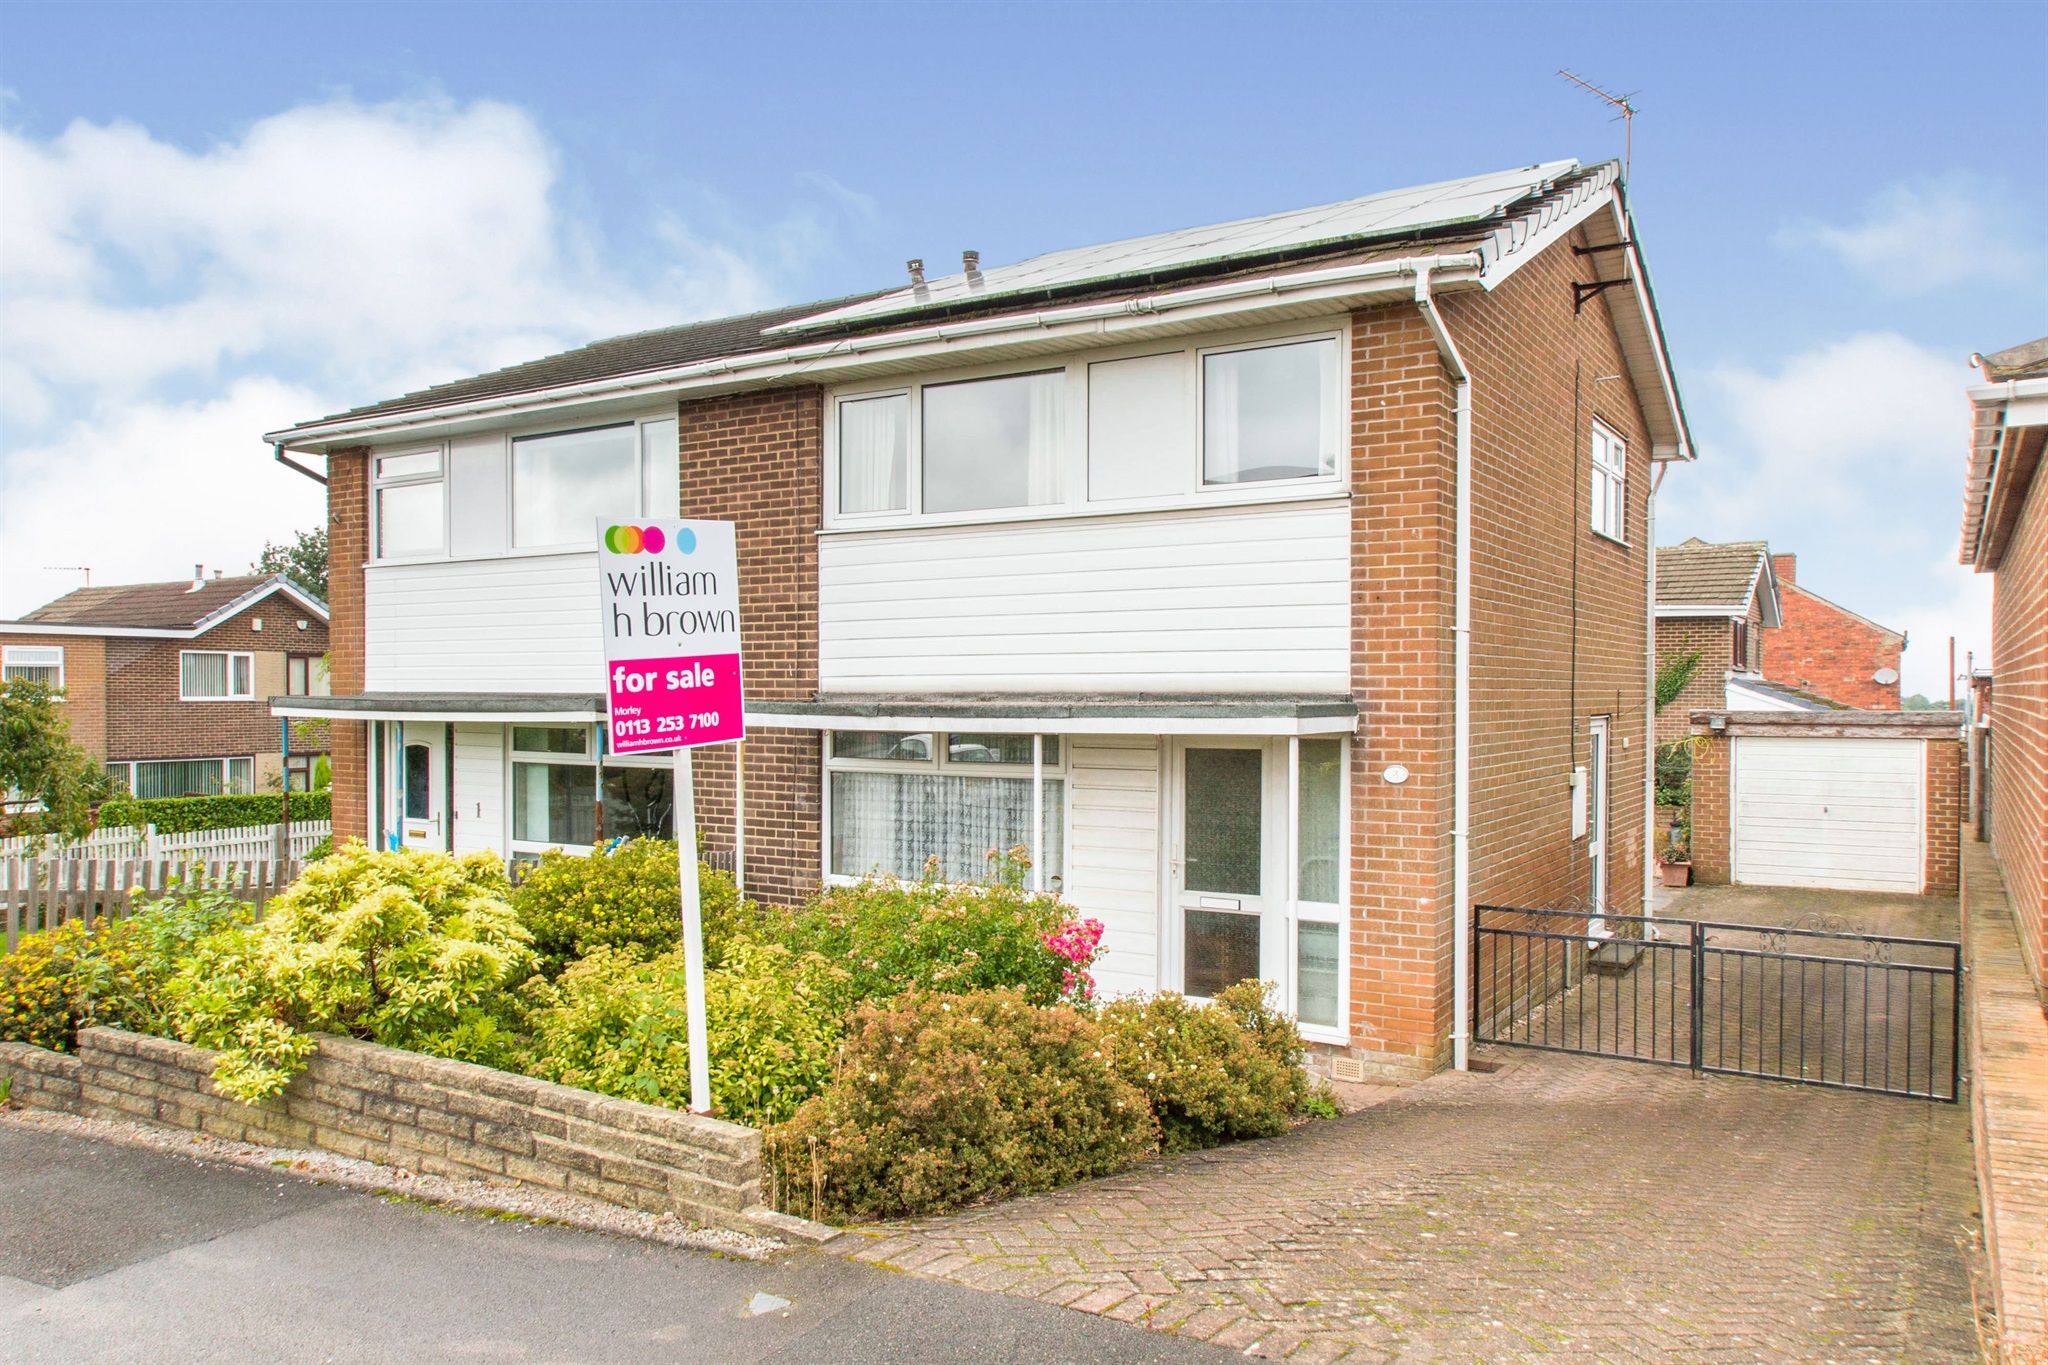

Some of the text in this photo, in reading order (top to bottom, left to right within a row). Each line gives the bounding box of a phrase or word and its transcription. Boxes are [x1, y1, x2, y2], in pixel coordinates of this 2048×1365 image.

[607, 561, 717, 597] william
[613, 601, 735, 637] h brown
[612, 661, 715, 693] for sale
[614, 706, 642, 717] Morley
[615, 711, 720, 737] 0113 253 7100
[616, 734, 682, 749] williamhbrown.co.uk
